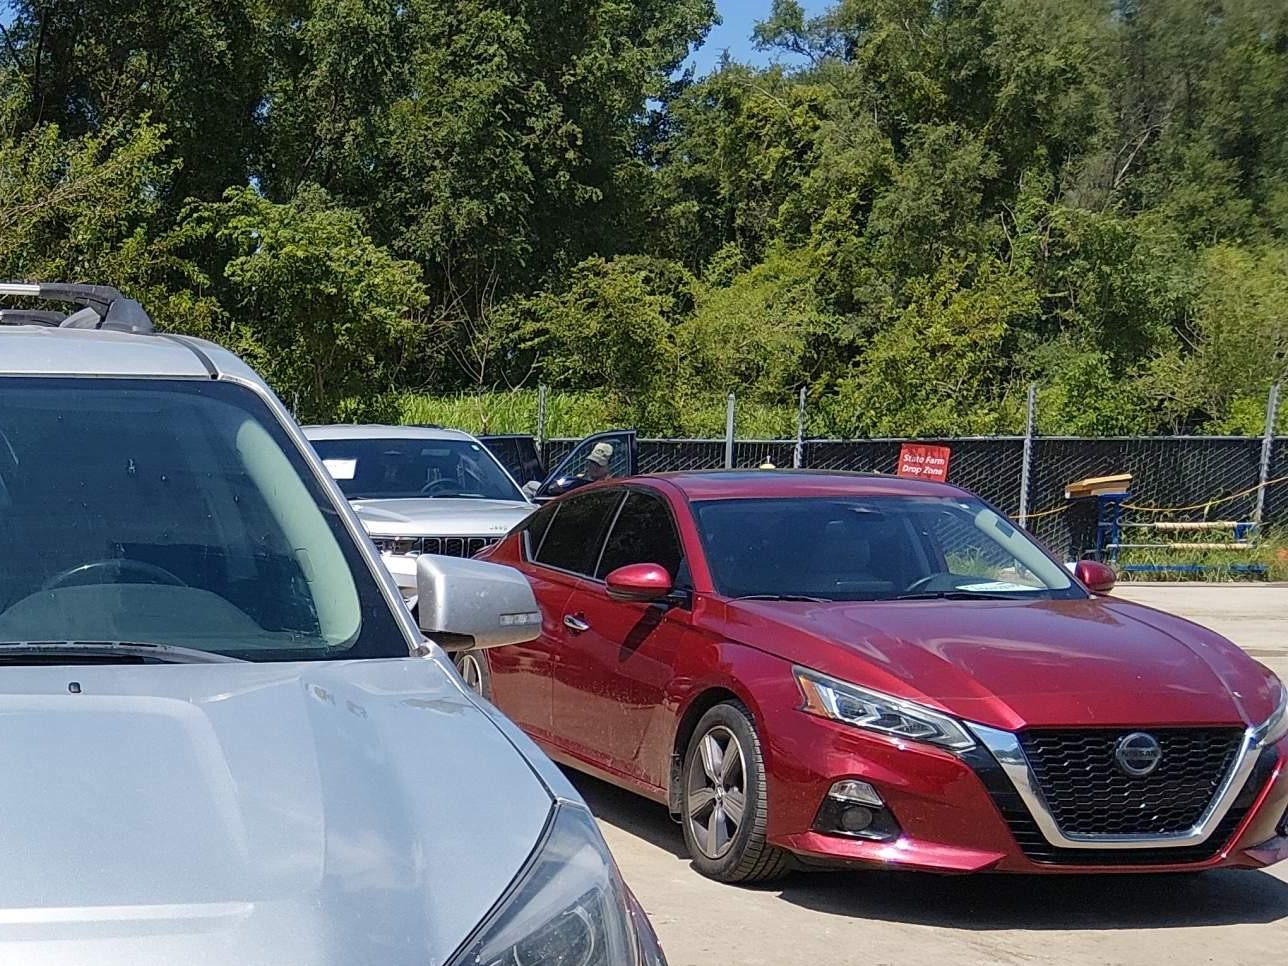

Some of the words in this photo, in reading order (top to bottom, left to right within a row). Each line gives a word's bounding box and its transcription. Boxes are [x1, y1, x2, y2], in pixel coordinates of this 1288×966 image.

[903, 454, 925, 464] State
[925, 456, 945, 465] Farm
[902, 464, 922, 475] Drop
[923, 466, 944, 476] Zone
